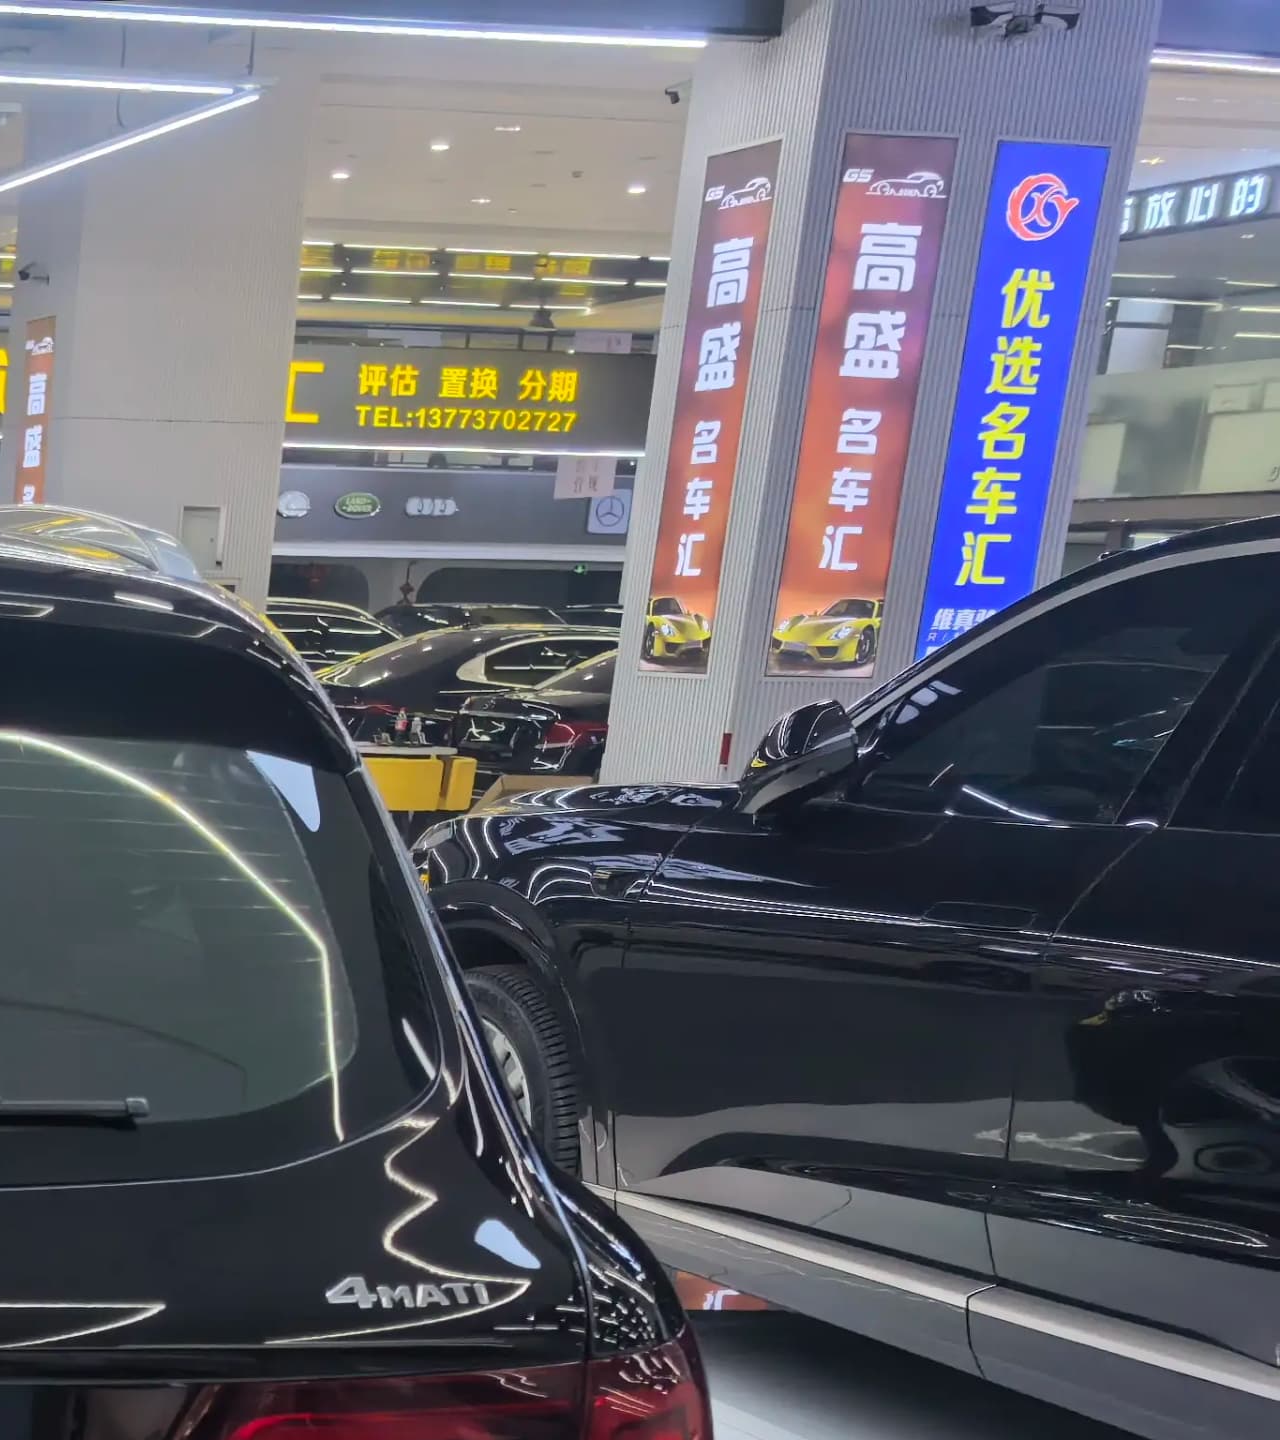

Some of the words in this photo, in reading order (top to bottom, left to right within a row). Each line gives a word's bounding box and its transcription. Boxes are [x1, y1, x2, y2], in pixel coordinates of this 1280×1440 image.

[842, 168, 874, 183] GS
[355, 404, 578, 433] TEL:13773702727
[358, 363, 420, 398] 评估
[438, 366, 498, 400] 置换
[518, 368, 579, 403] 分期
[674, 237, 755, 577] 高盛名车汇
[819, 222, 923, 572] 高盛名车汇
[954, 267, 1056, 586] 优选名车汇
